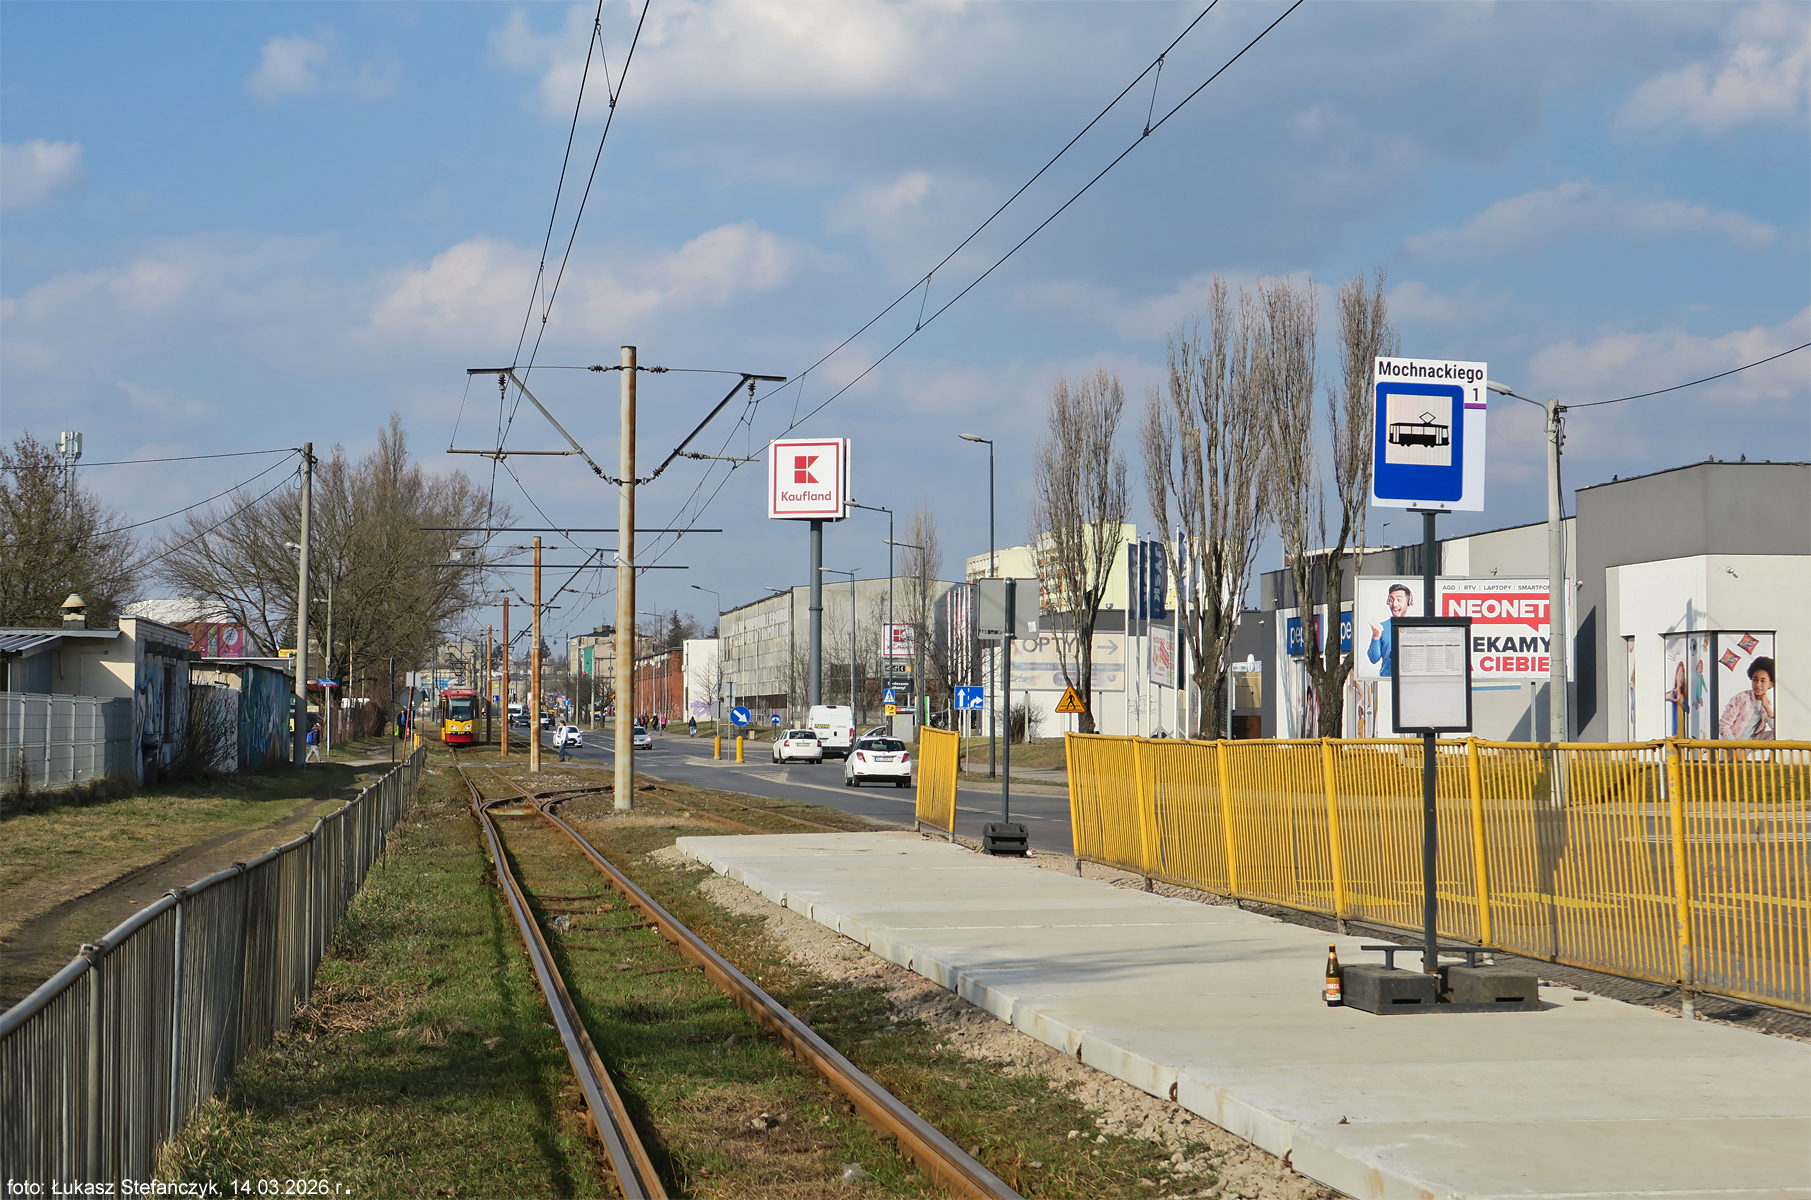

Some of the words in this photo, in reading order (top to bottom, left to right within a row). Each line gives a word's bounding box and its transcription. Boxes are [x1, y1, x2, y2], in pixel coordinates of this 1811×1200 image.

[1378, 361, 1484, 383] Mochnackiego
[1472, 387, 1479, 401] 1
[781, 490, 832, 501] Kaufland
[1448, 599, 1550, 618] NEONET
[1022, 636, 1077, 654] OPTY
[1473, 636, 1550, 653] EKAMY
[1479, 656, 1550, 672] CIEBIE
